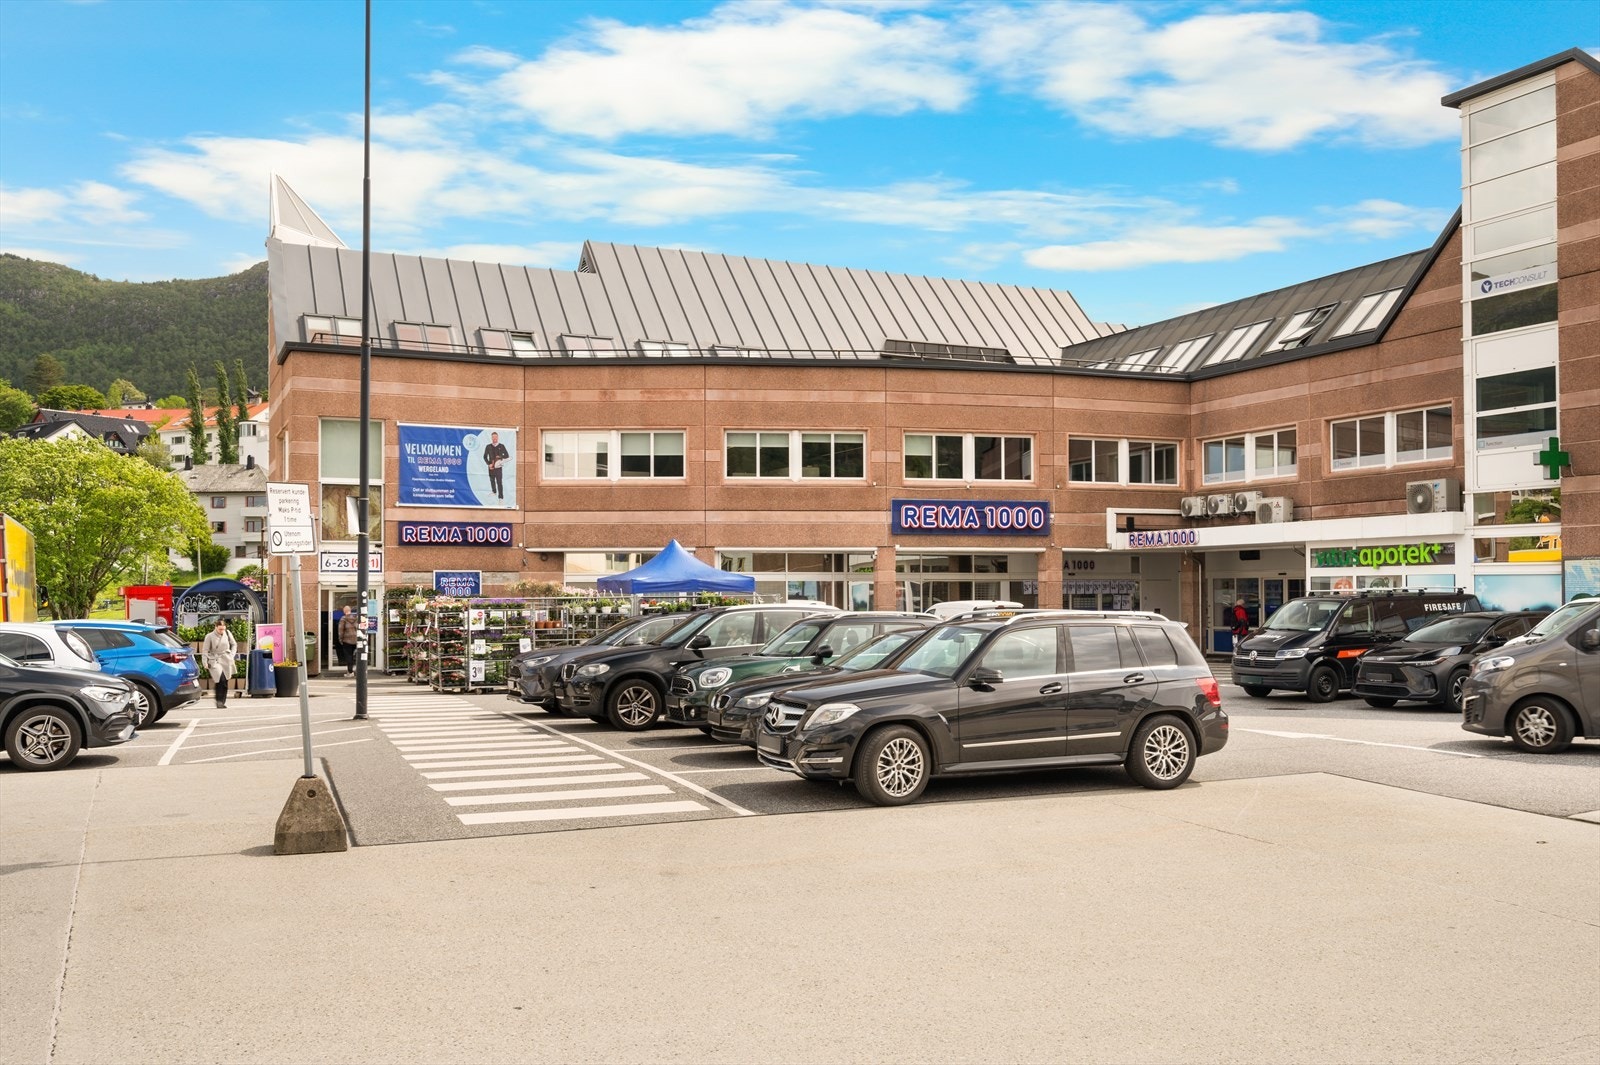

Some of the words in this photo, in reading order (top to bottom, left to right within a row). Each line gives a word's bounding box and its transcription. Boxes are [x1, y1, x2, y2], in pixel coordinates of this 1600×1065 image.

[1494, 270, 1548, 289] TECHCONSULT
[405, 443, 462, 456] VELKOMMEN
[407, 456, 415, 464] TIL
[417, 456, 442, 465] REMA
[443, 457, 462, 466] 1000
[418, 465, 449, 473] WERGELAND
[269, 487, 291, 495] Reservert
[278, 498, 299, 506] parkering
[901, 504, 980, 530] REMA
[985, 505, 1045, 530] 1000
[402, 525, 462, 543] REMA
[466, 526, 511, 544] 1000
[1128, 530, 1165, 548] REMA
[1167, 528, 1198, 546] 1000
[325, 558, 350, 568] 6-23
[1072, 560, 1095, 570] 1000
[440, 577, 475, 587] REMA
[444, 587, 472, 597] 1000
[1424, 602, 1462, 612] FIRESAFE
